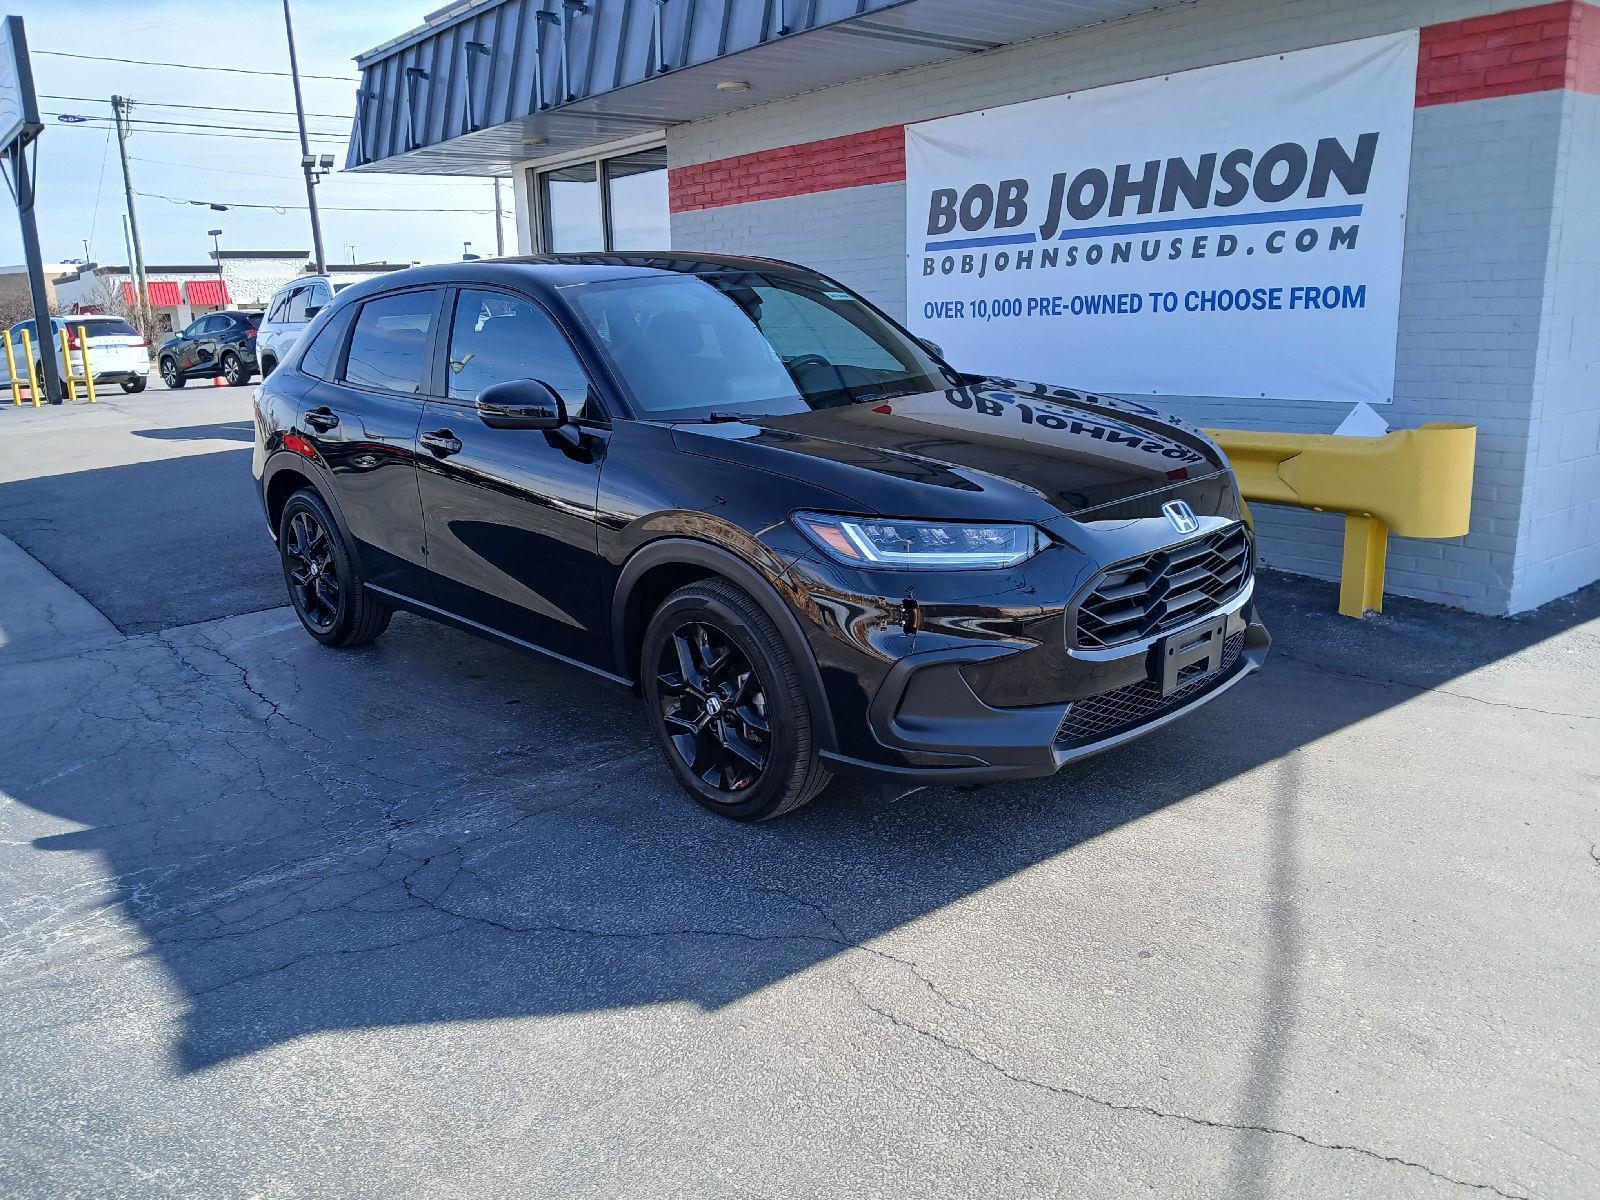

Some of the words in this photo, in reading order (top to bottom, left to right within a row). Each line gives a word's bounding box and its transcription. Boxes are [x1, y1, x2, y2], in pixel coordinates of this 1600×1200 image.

[926, 178, 1029, 236] BOB
[1038, 131, 1381, 241] JOHNSON
[922, 224, 1360, 279] BOBJOHNSONUSED.COM
[923, 301, 965, 320] OVER
[969, 297, 1023, 323] 10,000
[1027, 293, 1143, 317] PRE-OWNED
[1148, 291, 1179, 313] TO
[1184, 287, 1283, 313] CHOOSE
[1289, 284, 1367, 310] FROM
